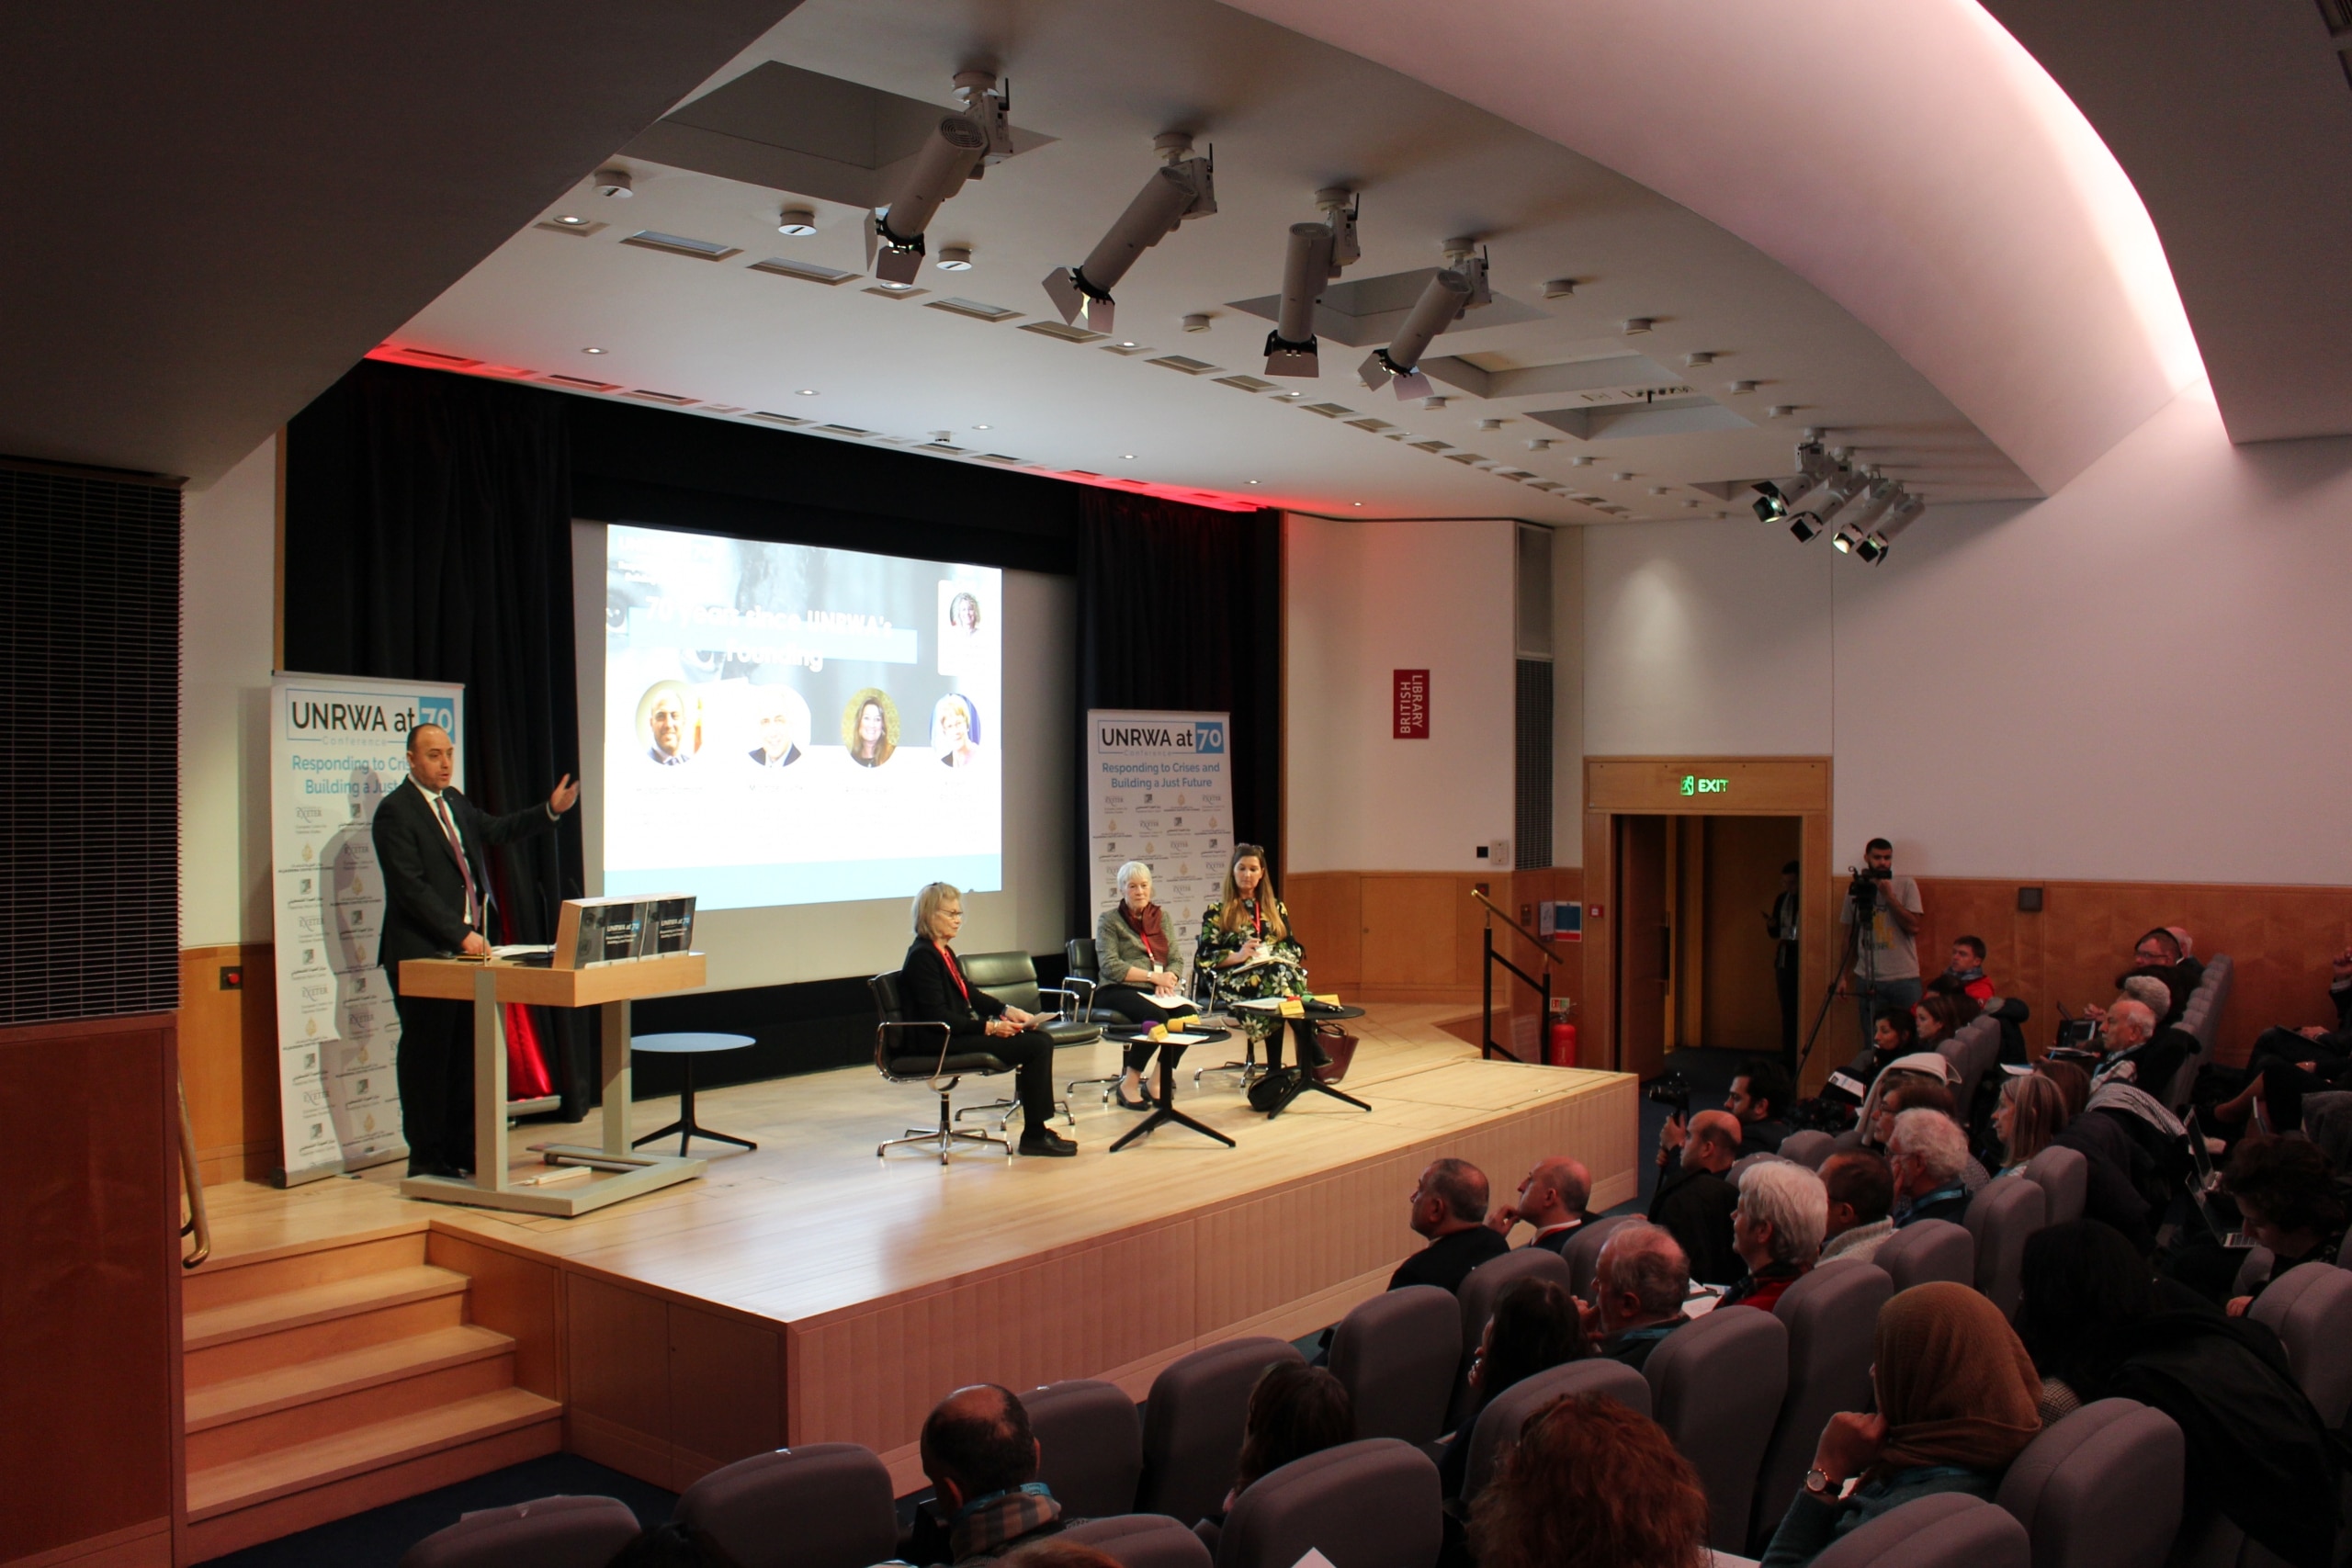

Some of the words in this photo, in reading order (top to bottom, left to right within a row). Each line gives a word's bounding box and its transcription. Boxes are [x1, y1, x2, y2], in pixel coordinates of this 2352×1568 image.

[746, 604, 799, 632] since
[1400, 682, 1411, 734] BRITISH
[1412, 675, 1423, 728] LIBRARY
[292, 701, 387, 732] UNRWA
[394, 707, 415, 732] at
[322, 737, 386, 747] Conference
[1102, 728, 1172, 747] UNRWA
[1176, 729, 1193, 747] at
[1197, 728, 1222, 750] 70
[292, 755, 369, 774] Responding
[372, 757, 385, 771] to
[388, 756, 411, 772] Cris
[1102, 762, 1159, 774] Responding
[1161, 763, 1170, 772] to
[1172, 762, 1200, 773] Crises
[1202, 762, 1220, 772] and
[305, 778, 360, 797] Building
[362, 784, 370, 793] a
[1111, 778, 1152, 790] Building
[1161, 778, 1180, 788] Just
[1182, 777, 1213, 787] Future
[1698, 779, 1728, 792] EXIT
